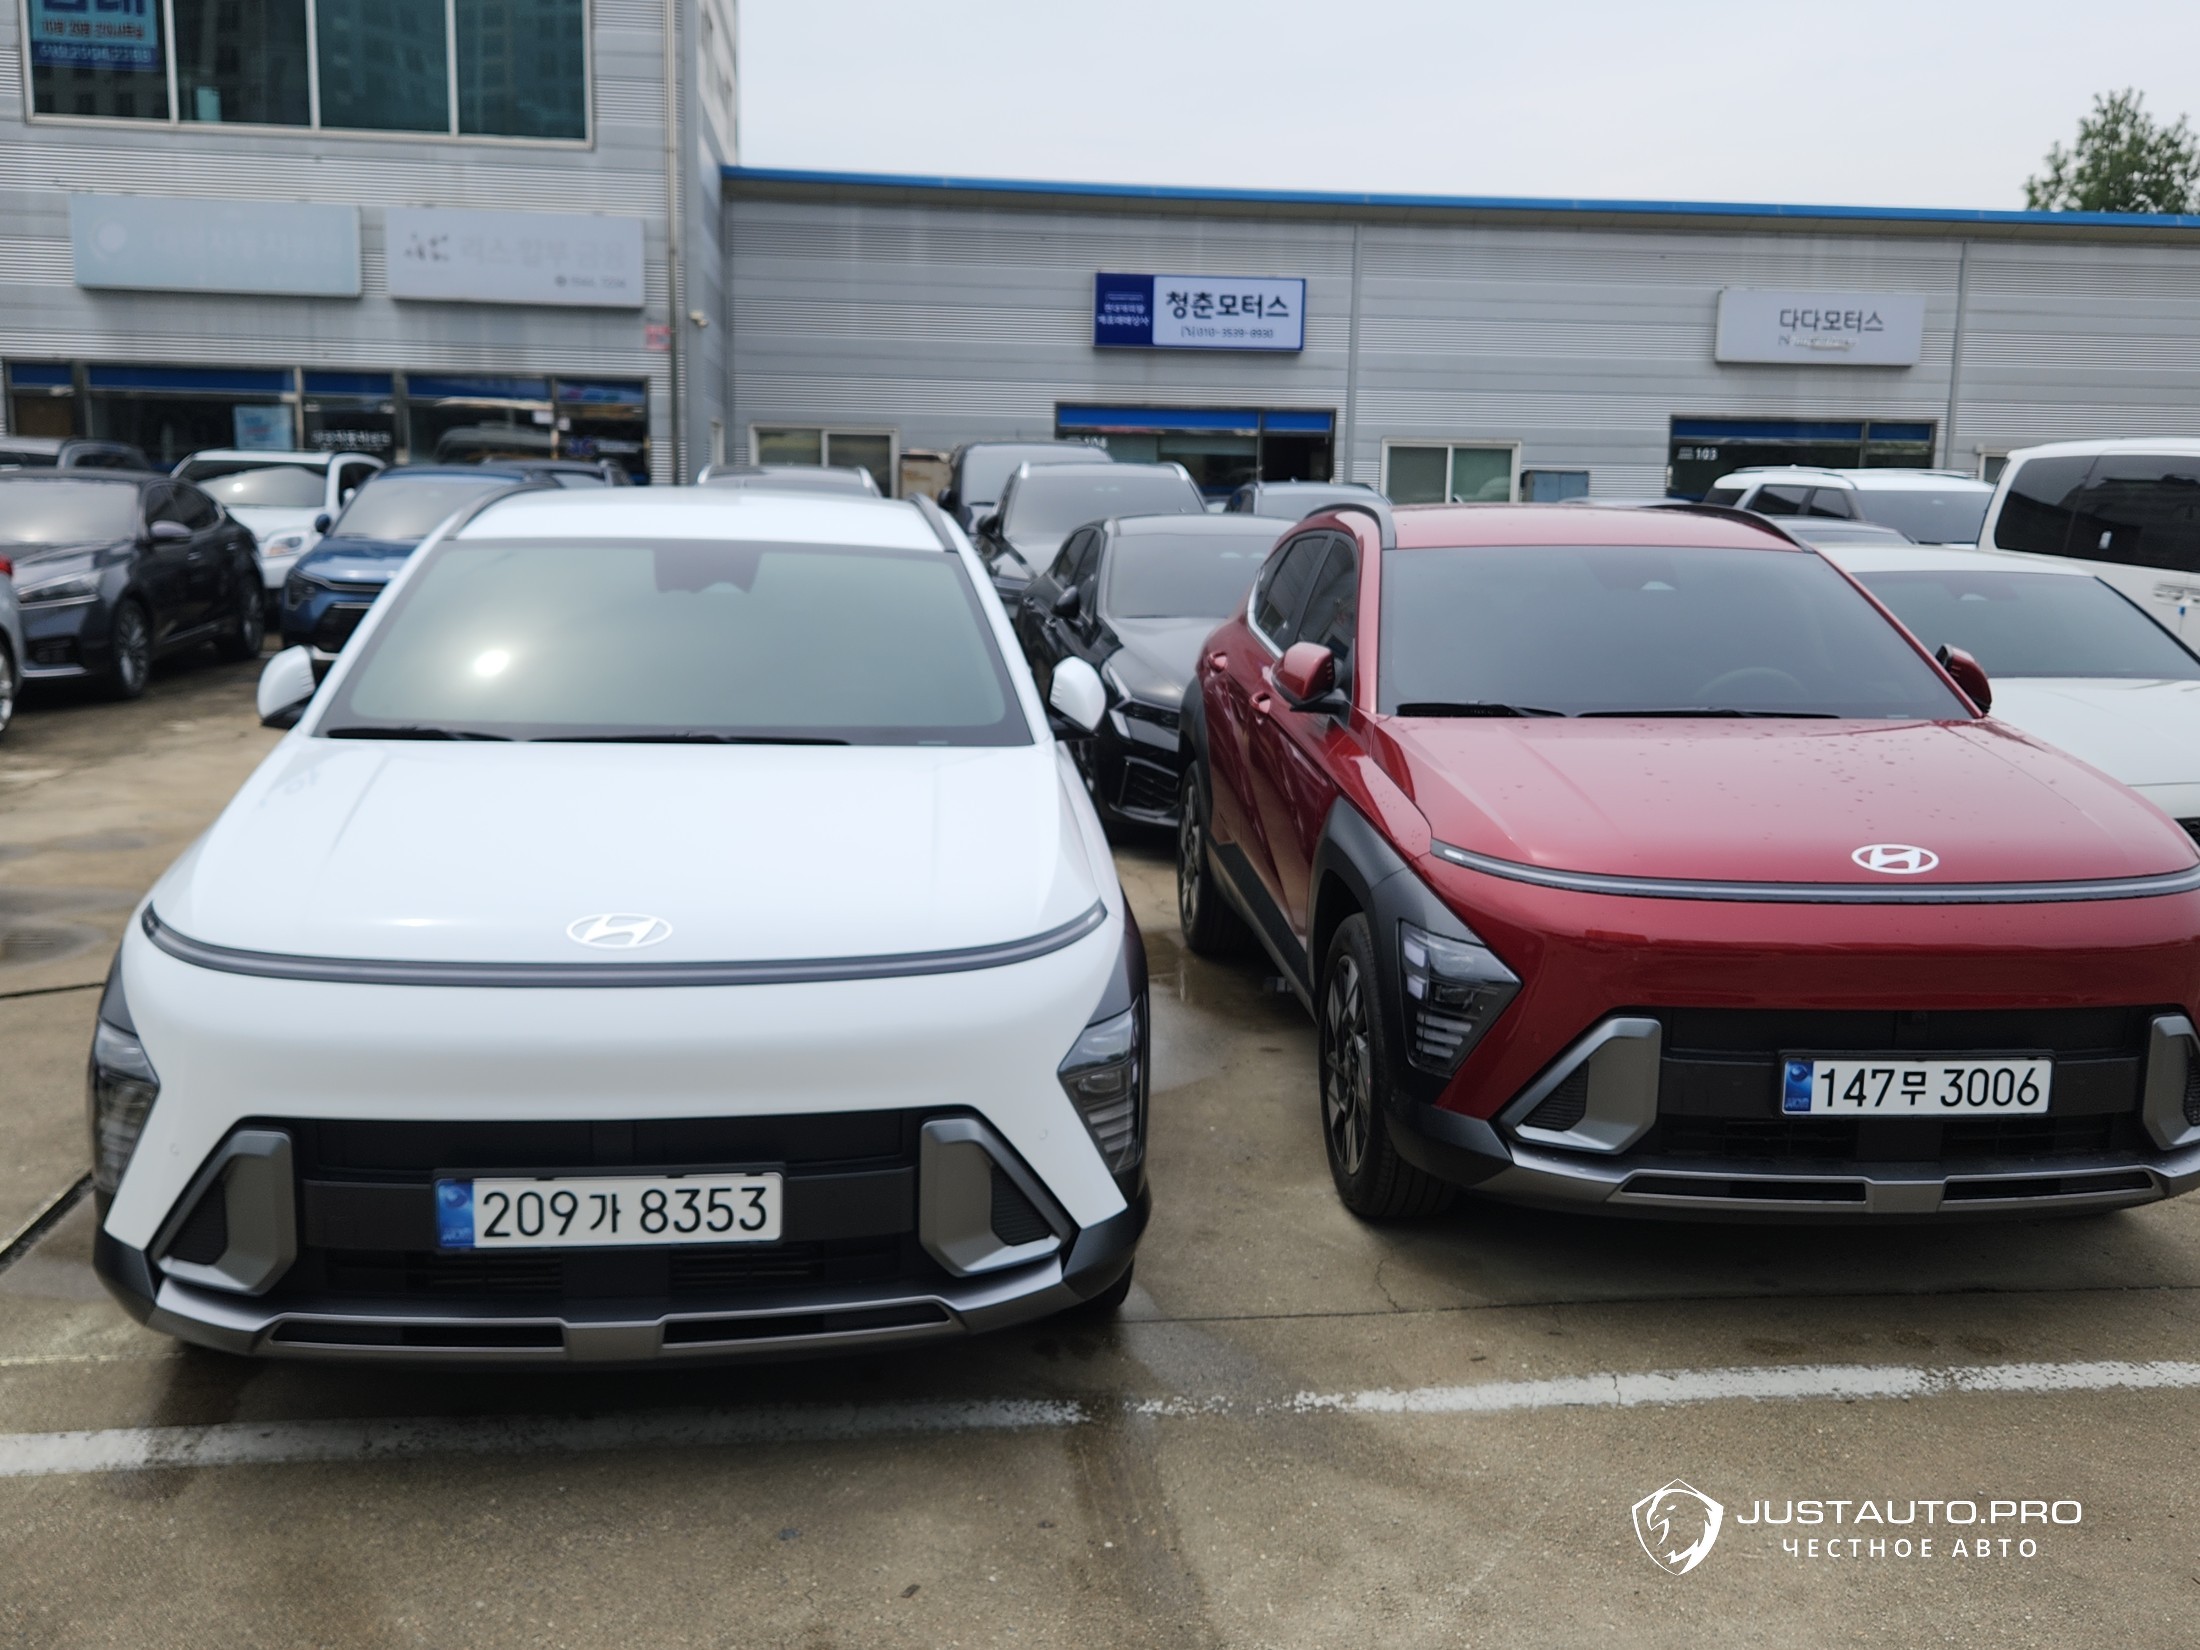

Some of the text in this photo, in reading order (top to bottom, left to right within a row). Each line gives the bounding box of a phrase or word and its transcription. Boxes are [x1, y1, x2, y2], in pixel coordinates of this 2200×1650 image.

[1166, 291, 1290, 319] 청춘모터스
[1779, 308, 1885, 333] 다다모터스
[1696, 446, 1719, 461] 103
[1820, 1067, 2040, 1108] 147무 3006
[483, 1186, 768, 1238] 209가 8353
